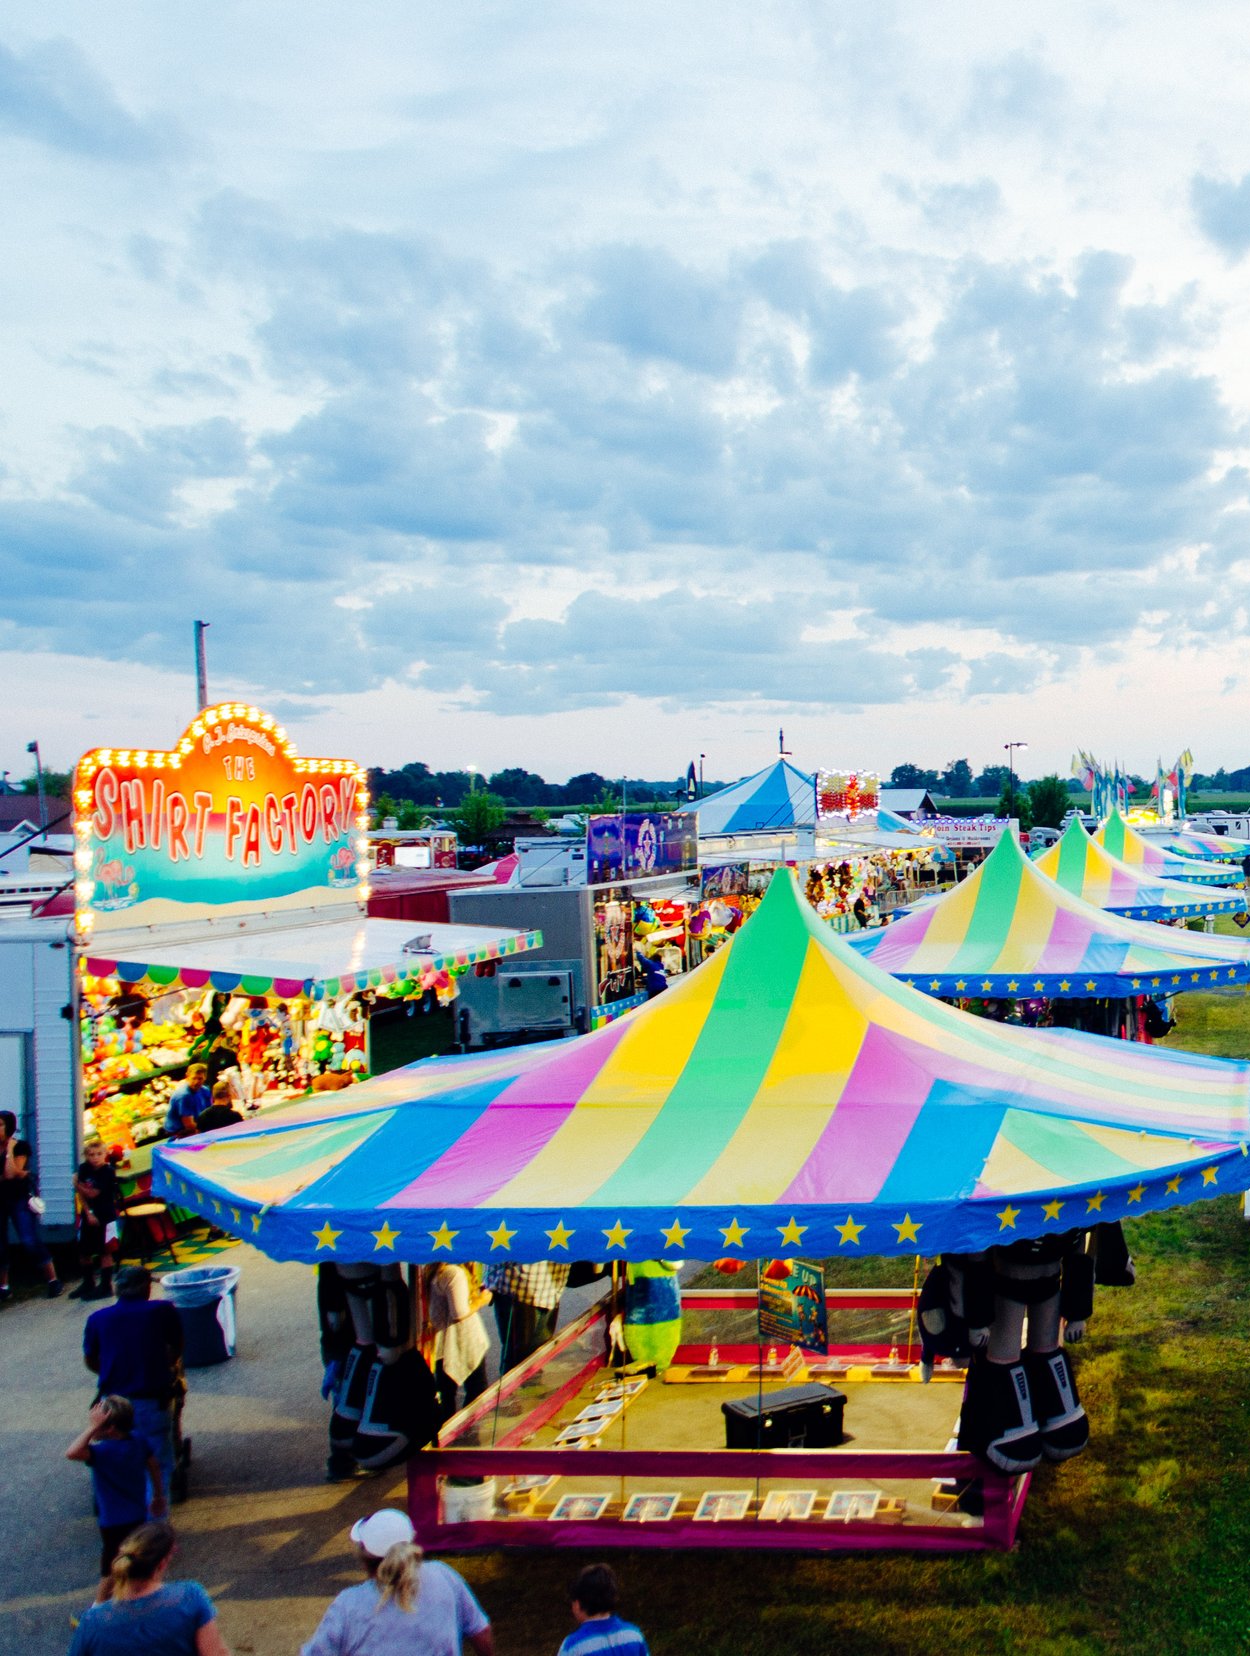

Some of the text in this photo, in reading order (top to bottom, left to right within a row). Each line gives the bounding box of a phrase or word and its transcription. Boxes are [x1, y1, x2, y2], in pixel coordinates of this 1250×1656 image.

[223, 756, 255, 781] THE
[93, 767, 357, 868] SHIRT FACTORY
[979, 824, 997, 832] Tips
[802, 1269, 816, 1287] UP
